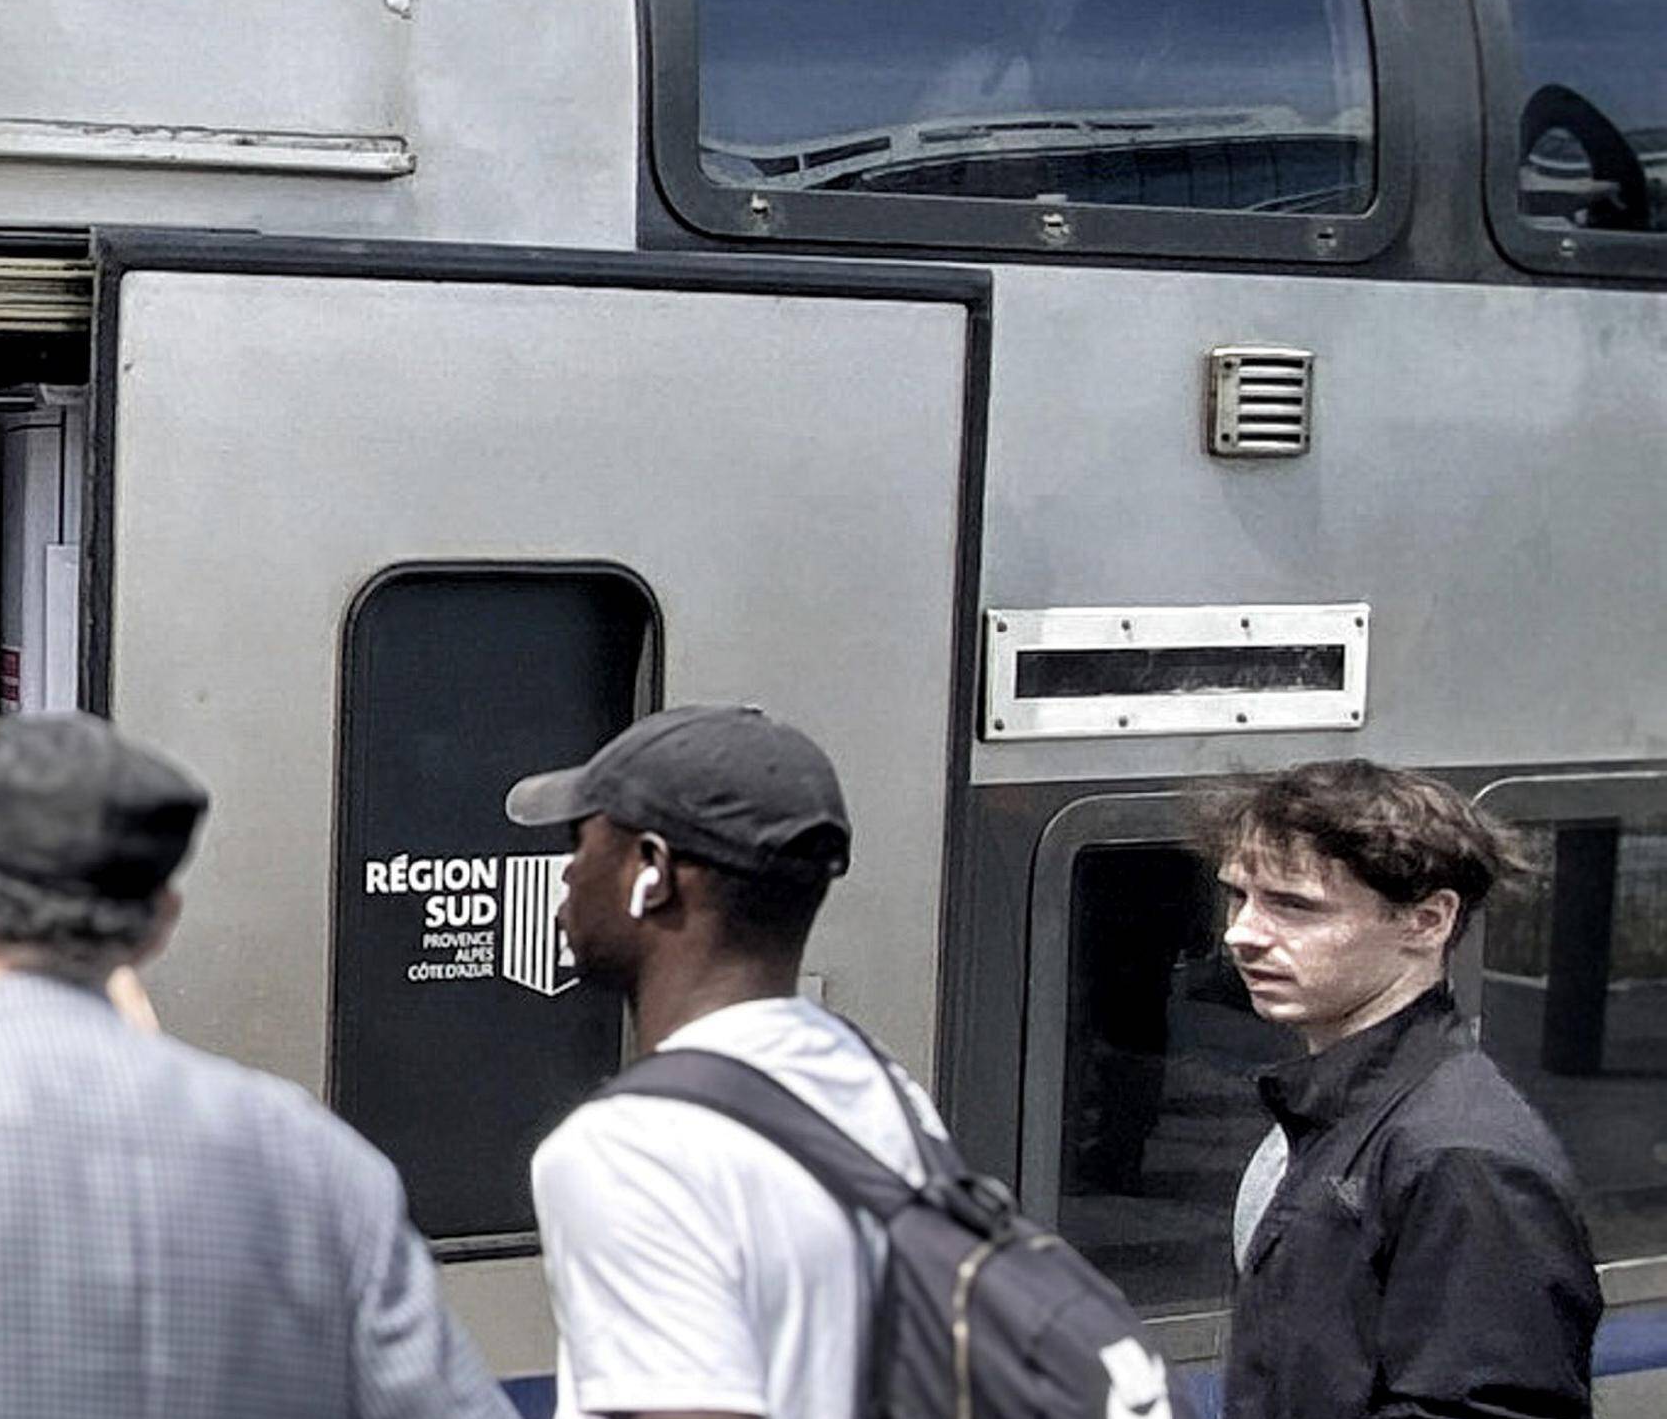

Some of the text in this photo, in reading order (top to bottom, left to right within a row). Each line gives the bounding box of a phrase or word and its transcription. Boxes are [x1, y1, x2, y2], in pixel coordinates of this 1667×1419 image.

[366, 853, 497, 893] RÉGION
[425, 894, 497, 928] SUD
[422, 930, 495, 949] PROVENCE
[454, 946, 495, 963] ALPES
